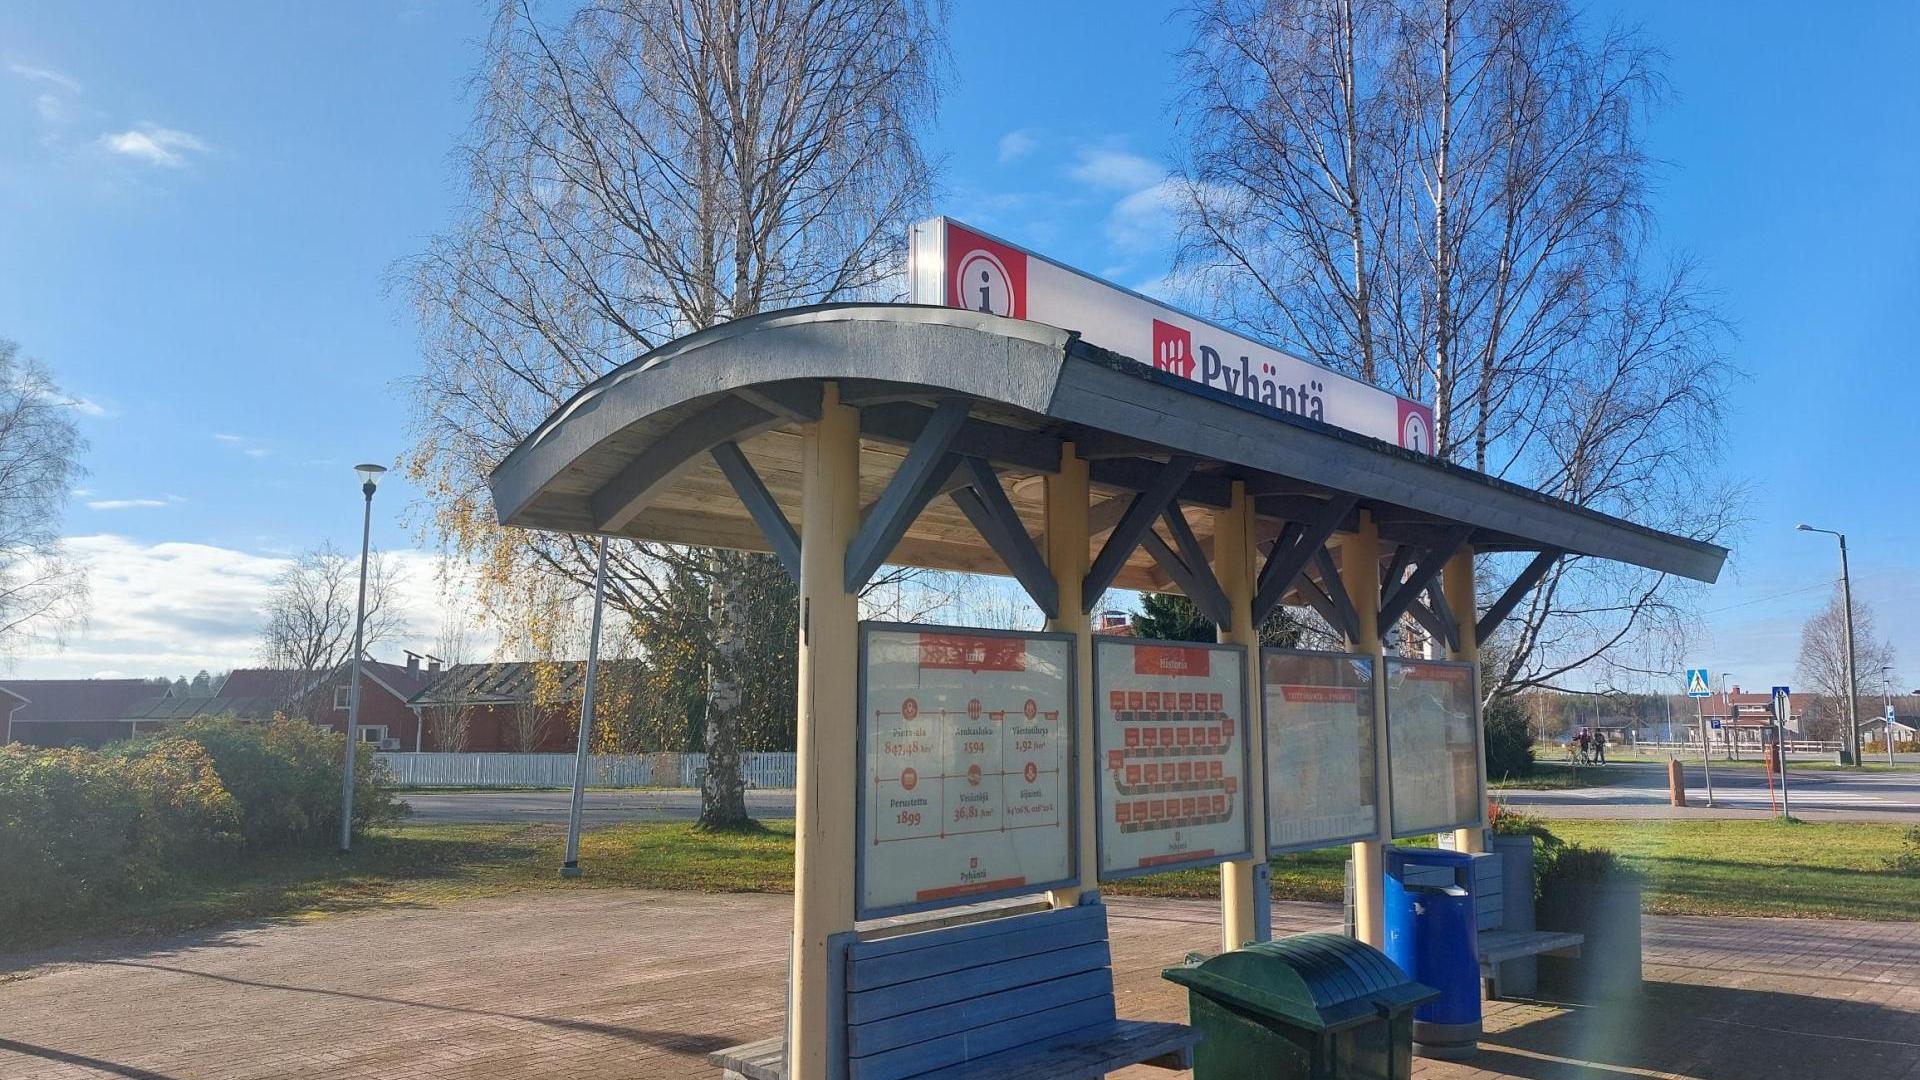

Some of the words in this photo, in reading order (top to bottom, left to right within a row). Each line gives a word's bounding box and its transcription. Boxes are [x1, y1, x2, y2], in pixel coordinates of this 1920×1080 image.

[1200, 345, 1325, 422] Pyhäntä
[963, 741, 984, 754] 1594
[896, 811, 922, 827] 1899
